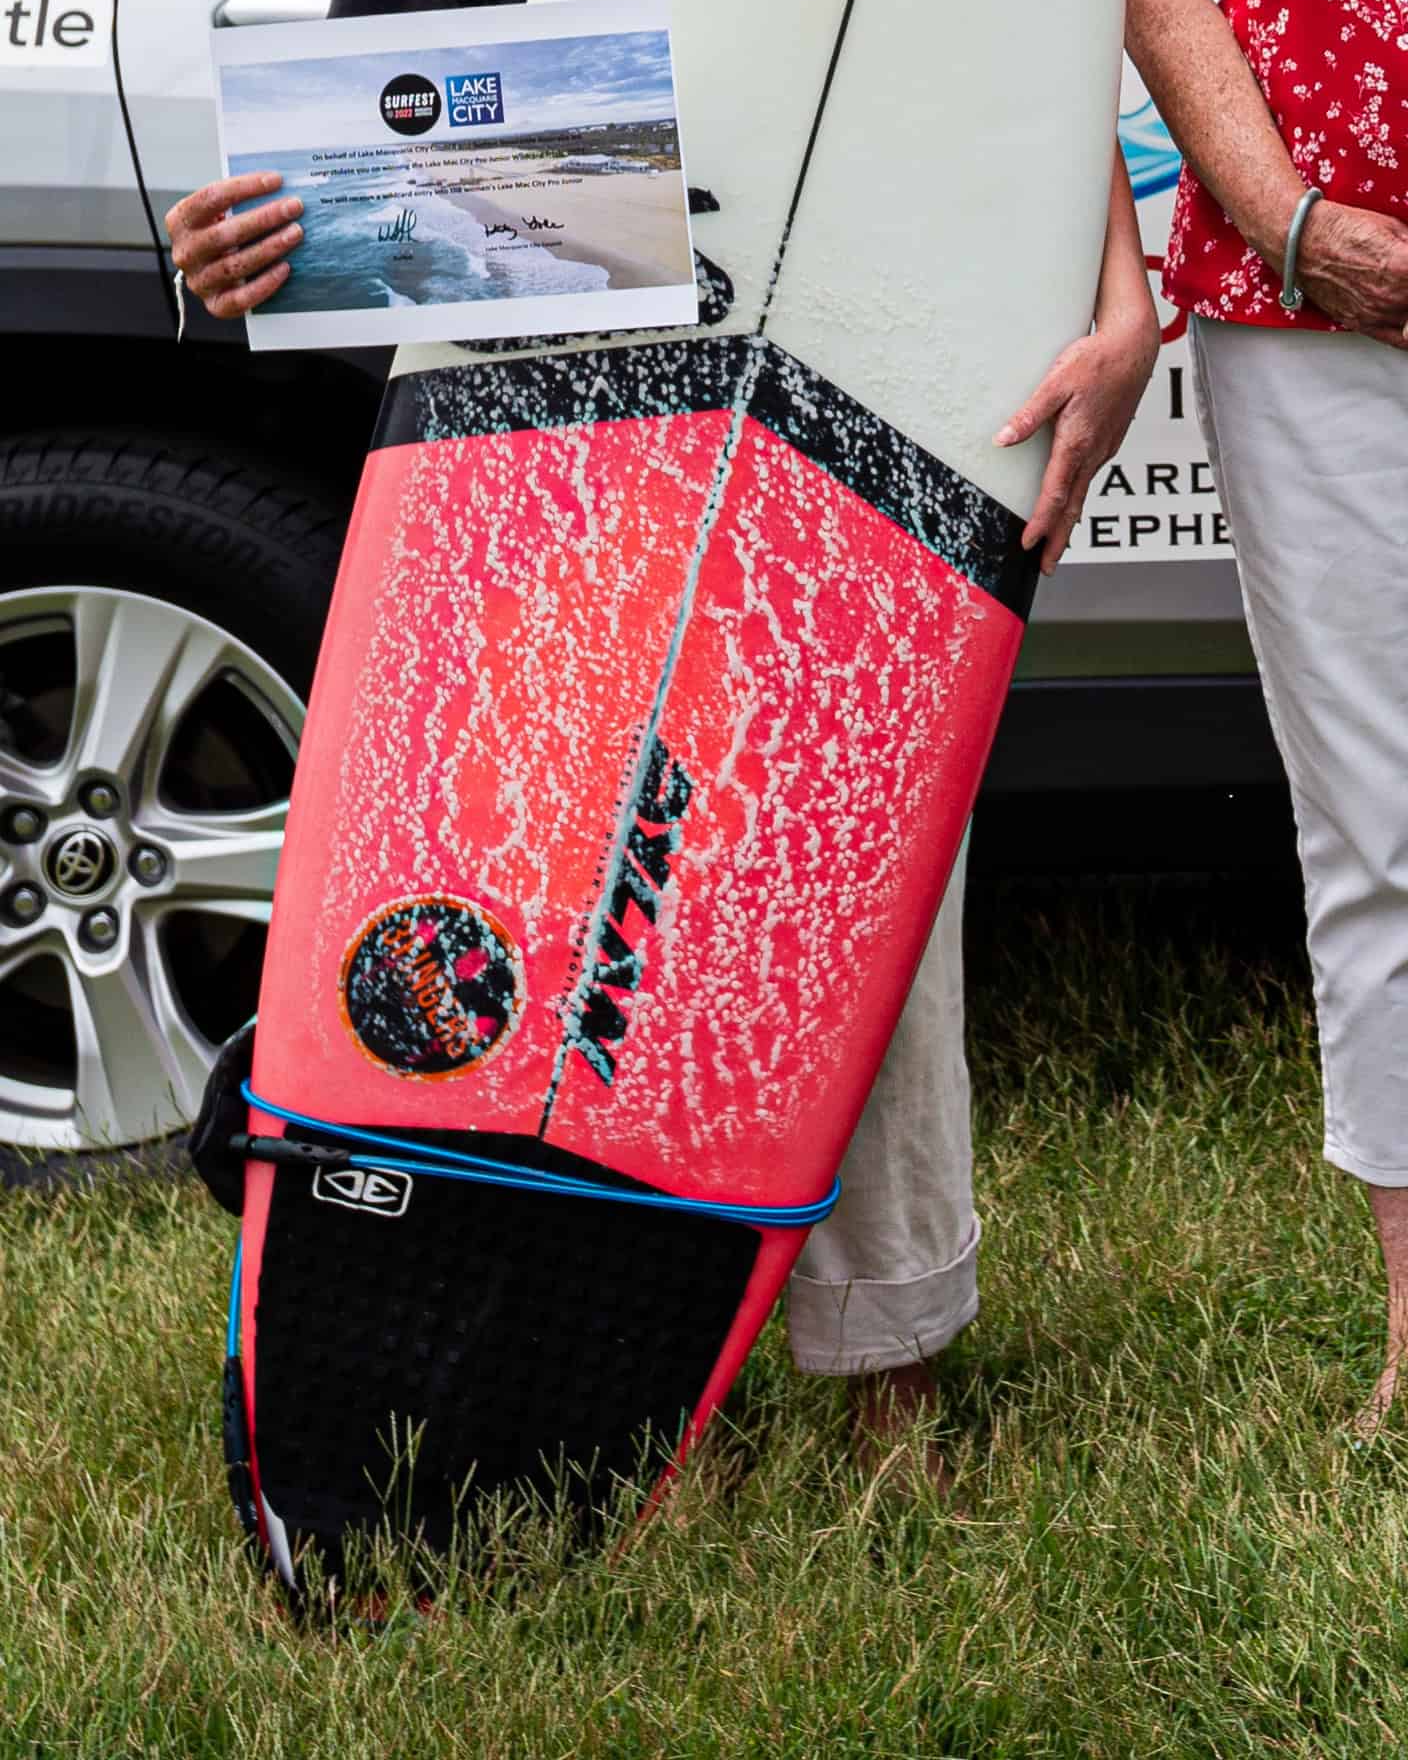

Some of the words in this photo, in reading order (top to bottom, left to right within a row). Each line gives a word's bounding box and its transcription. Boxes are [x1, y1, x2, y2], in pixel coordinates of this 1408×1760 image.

[450, 77, 497, 96] LAKE
[384, 92, 435, 109] SURFEST
[453, 103, 498, 122] CITY
[414, 145, 429, 153] City
[443, 158, 458, 166] Mac
[460, 157, 473, 166] City
[497, 182, 513, 191] Lake
[515, 181, 530, 189] Mac
[531, 180, 546, 188] City
[1068, 512, 1233, 549] EPHE
